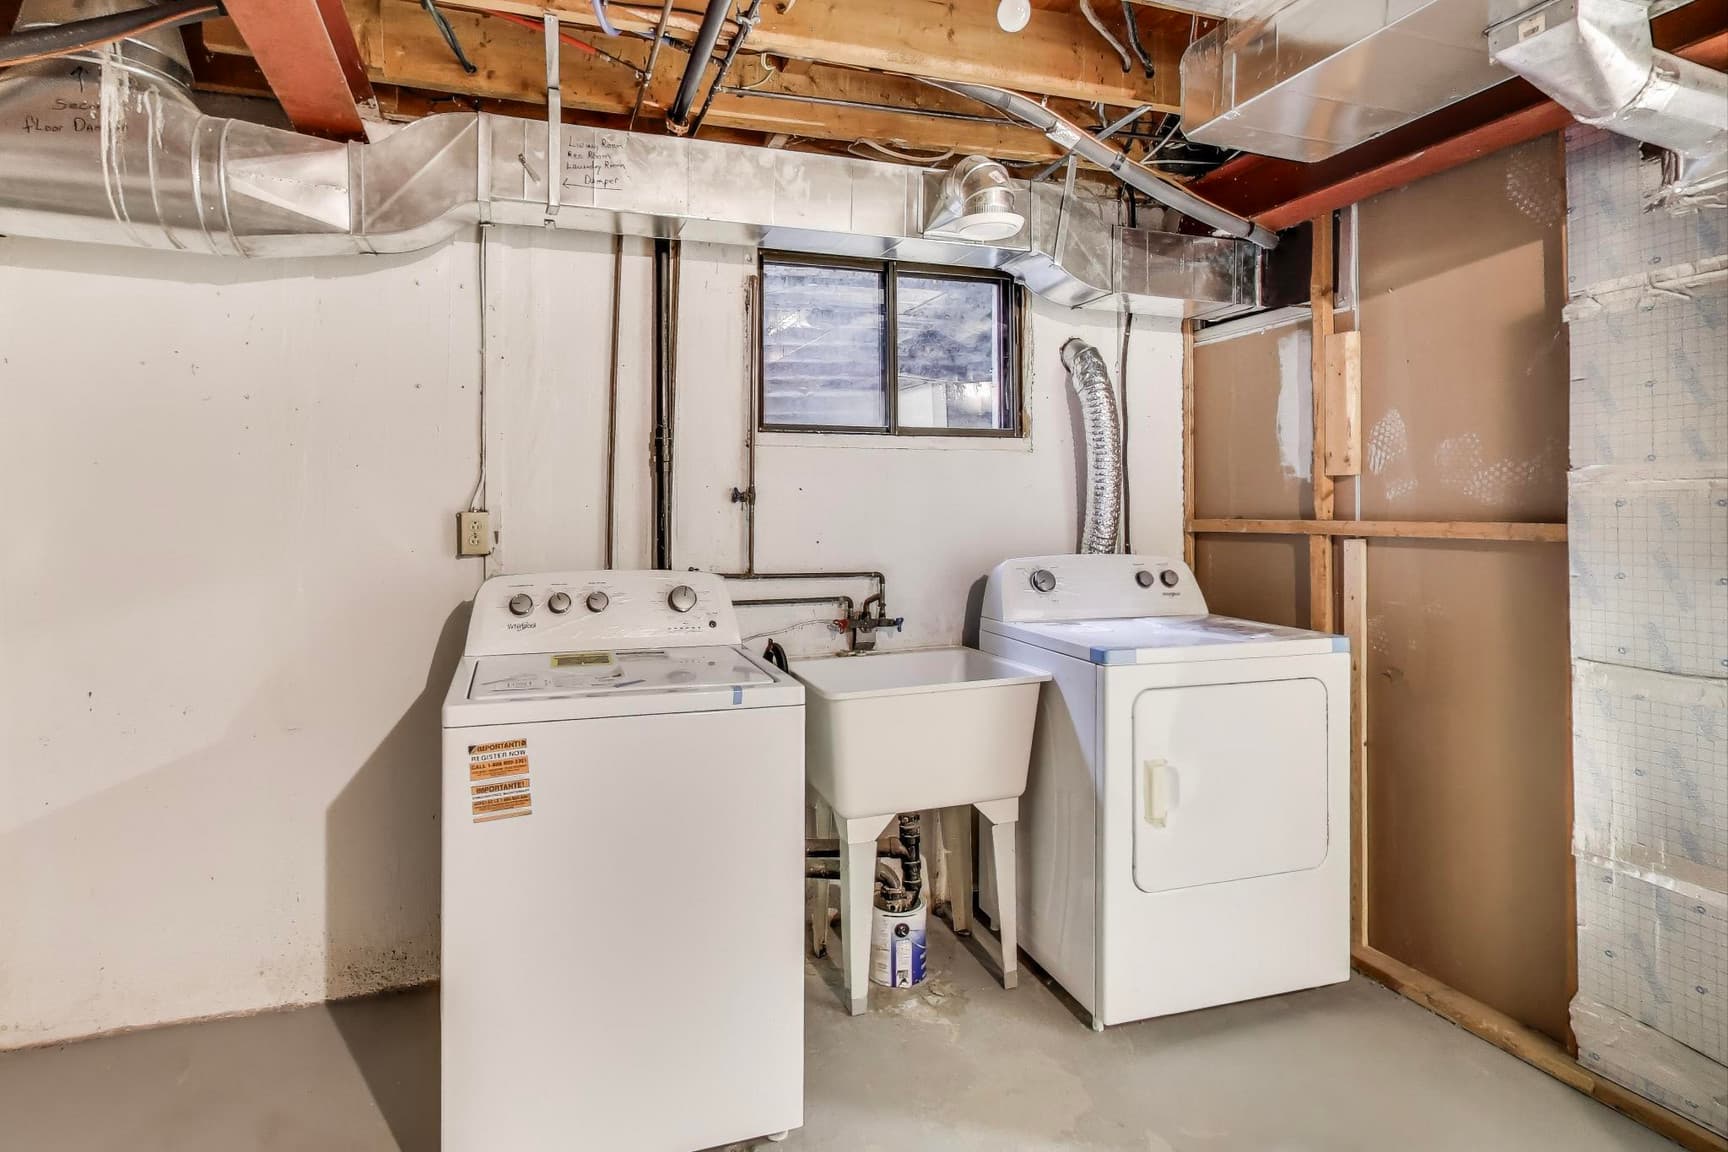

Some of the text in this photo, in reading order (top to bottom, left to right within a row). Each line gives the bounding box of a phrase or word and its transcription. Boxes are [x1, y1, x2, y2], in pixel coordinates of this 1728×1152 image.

[584, 174, 619, 189] Damper
[471, 749, 526, 761] REGISTER NOW
